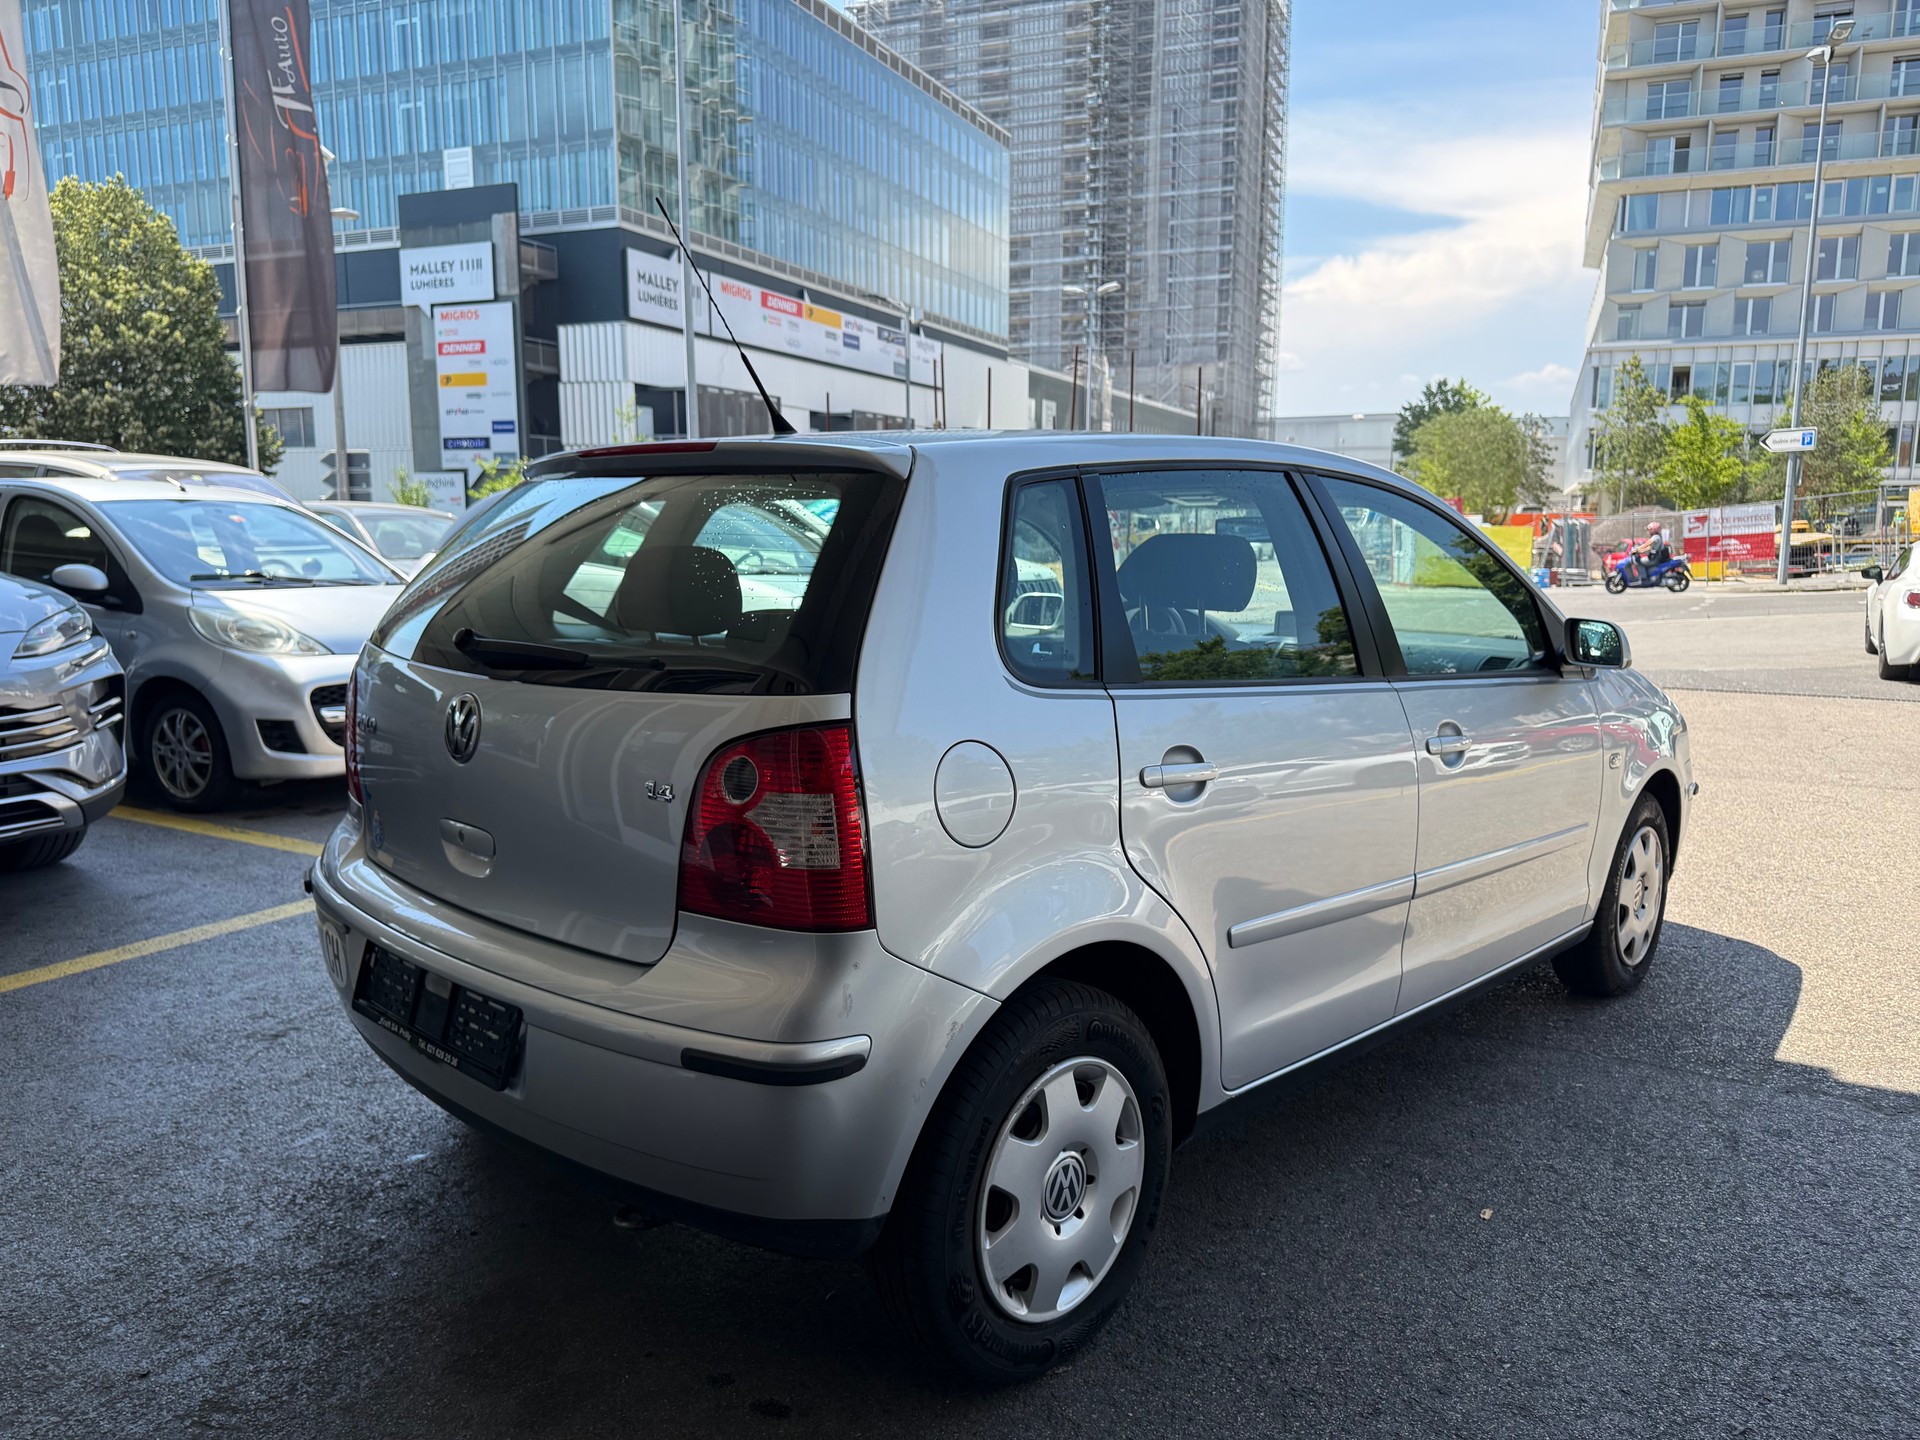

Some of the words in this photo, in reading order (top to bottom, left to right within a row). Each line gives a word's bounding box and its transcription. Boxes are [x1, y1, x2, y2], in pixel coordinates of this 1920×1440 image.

[410, 260, 456, 276] MALLEY
[410, 277, 455, 291] LUMIÈRES
[636, 270, 679, 294] MALLEY
[719, 281, 753, 302] MIGROS
[638, 289, 679, 312] LUMIÈRES
[766, 295, 798, 315] DENNER
[440, 309, 480, 321] MIGROS
[442, 342, 482, 354] DENNER
[325, 929, 344, 983] CH
